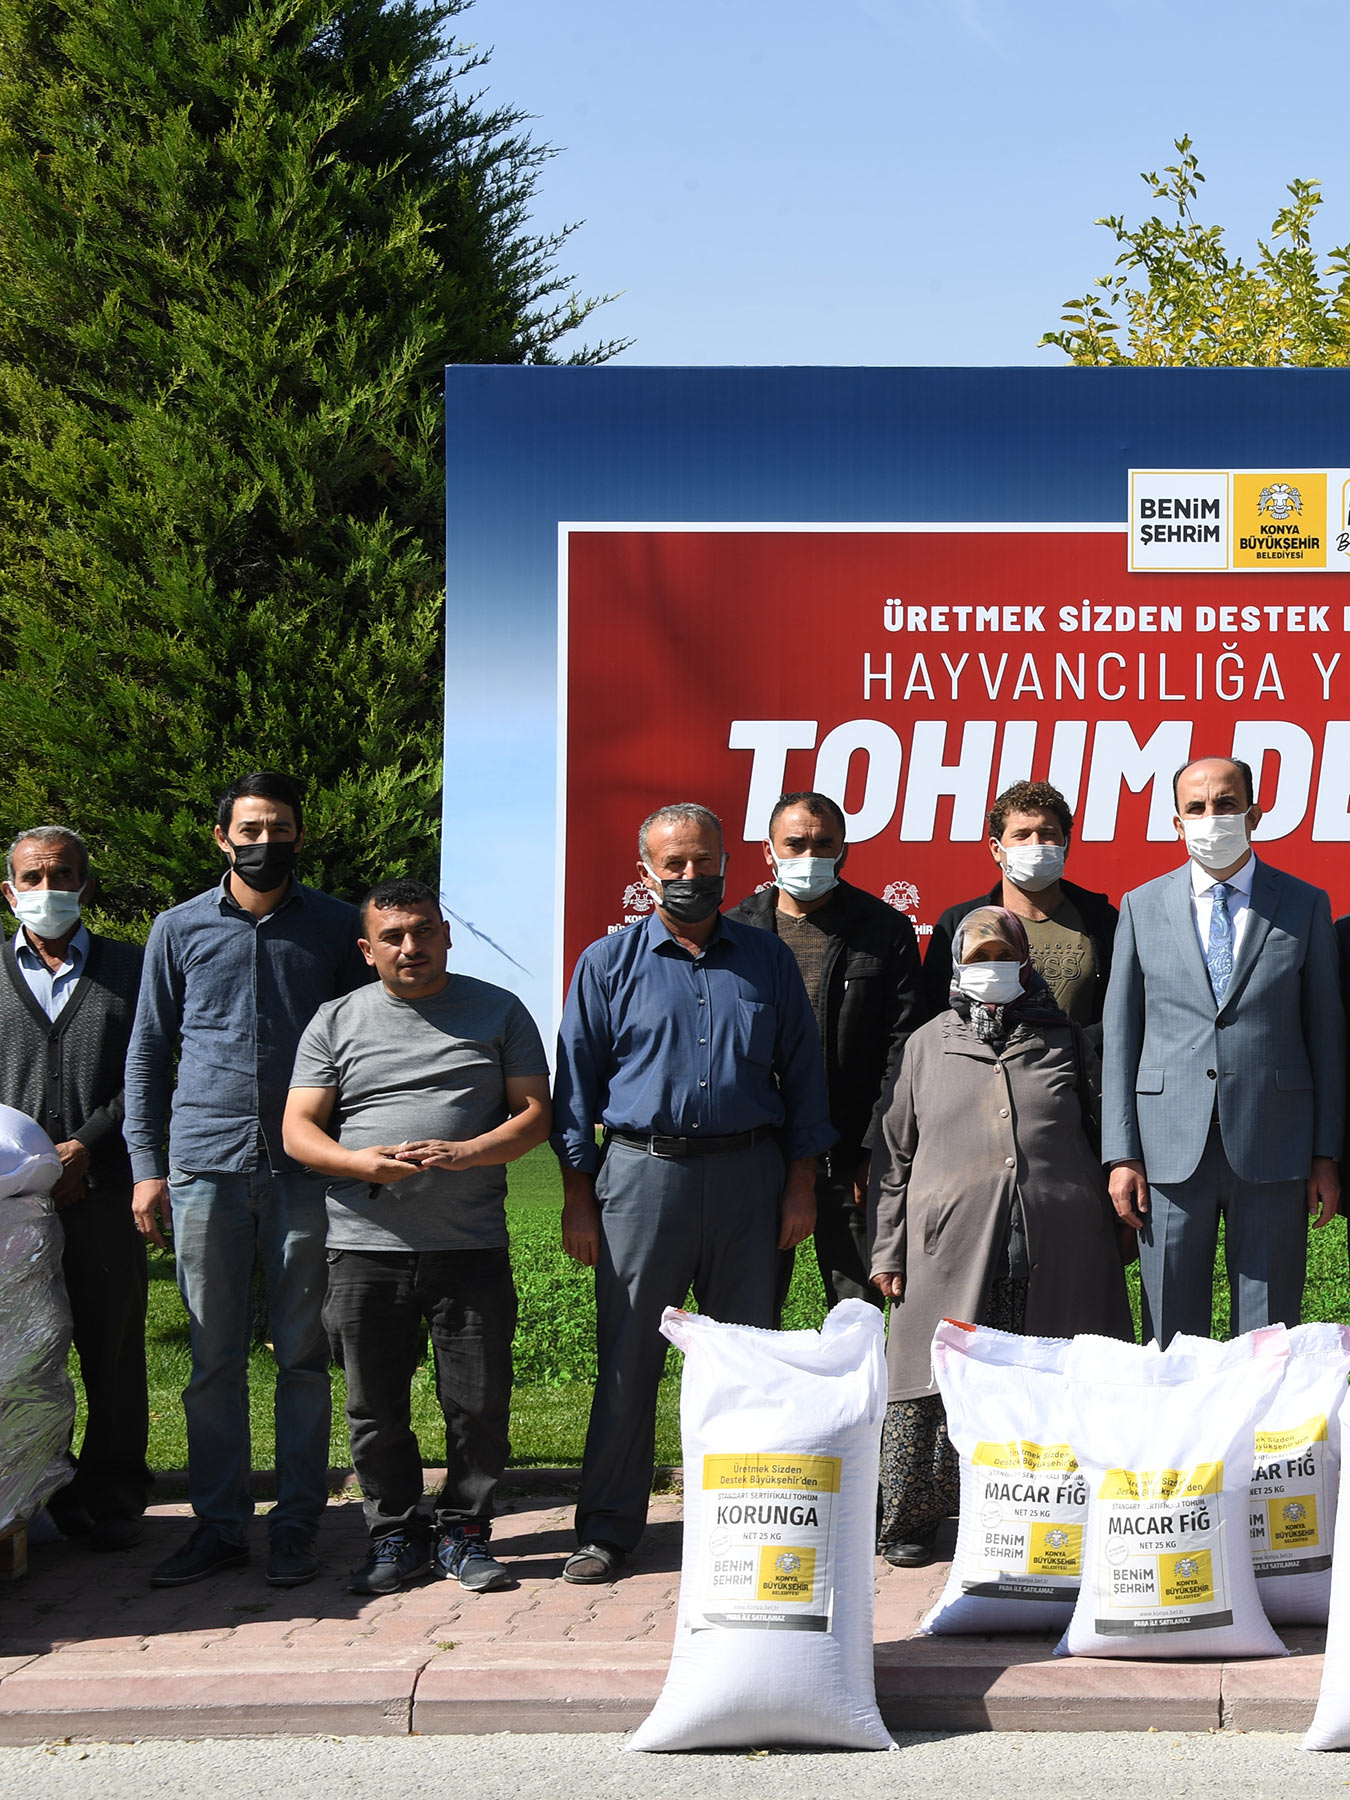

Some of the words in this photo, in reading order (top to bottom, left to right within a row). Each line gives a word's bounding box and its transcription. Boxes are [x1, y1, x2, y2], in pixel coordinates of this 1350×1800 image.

[1261, 525, 1300, 535] KONYA
[1240, 535, 1319, 552] BÜYÜKŞEHİR
[883, 598, 1046, 632] ÜRETMEK
[1060, 600, 1182, 632] SİZDEN
[1196, 605, 1330, 632] DESTEK
[863, 642, 1285, 701] HAYVANCILIĞA
[727, 719, 1194, 843] TOHUM
[734, 1463, 769, 1473] Üretmek
[772, 1465, 801, 1473] Sizden
[720, 1476, 747, 1484] Destek
[750, 1476, 817, 1486] Büyükşehir'den
[985, 1483, 1049, 1503] MACAR
[717, 1506, 818, 1526] KORUNGA
[1109, 1517, 1174, 1535] MACAR
